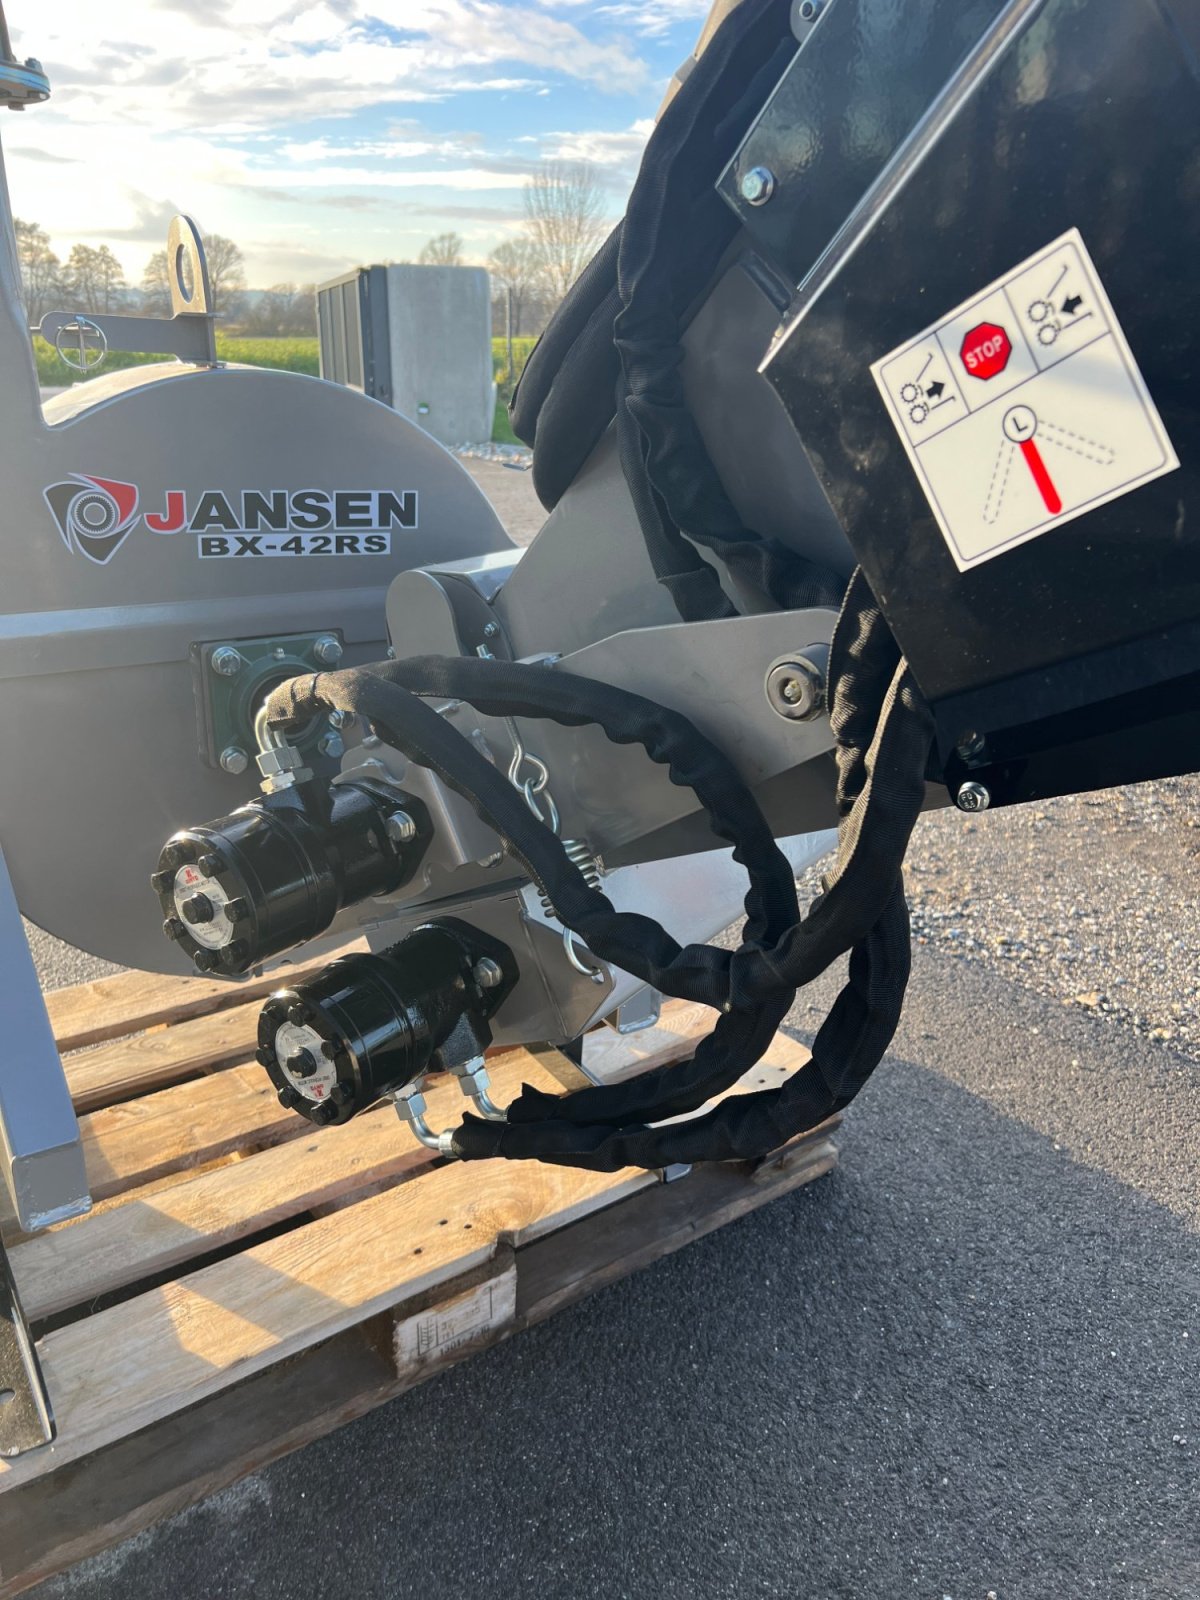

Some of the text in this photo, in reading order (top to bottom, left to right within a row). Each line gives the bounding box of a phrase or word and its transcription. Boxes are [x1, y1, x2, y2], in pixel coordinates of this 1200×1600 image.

[965, 335, 1004, 369] STOP
[1012, 417, 1028, 432] L
[145, 490, 418, 533] JANSEN
[200, 535, 388, 556] BX-42RS
